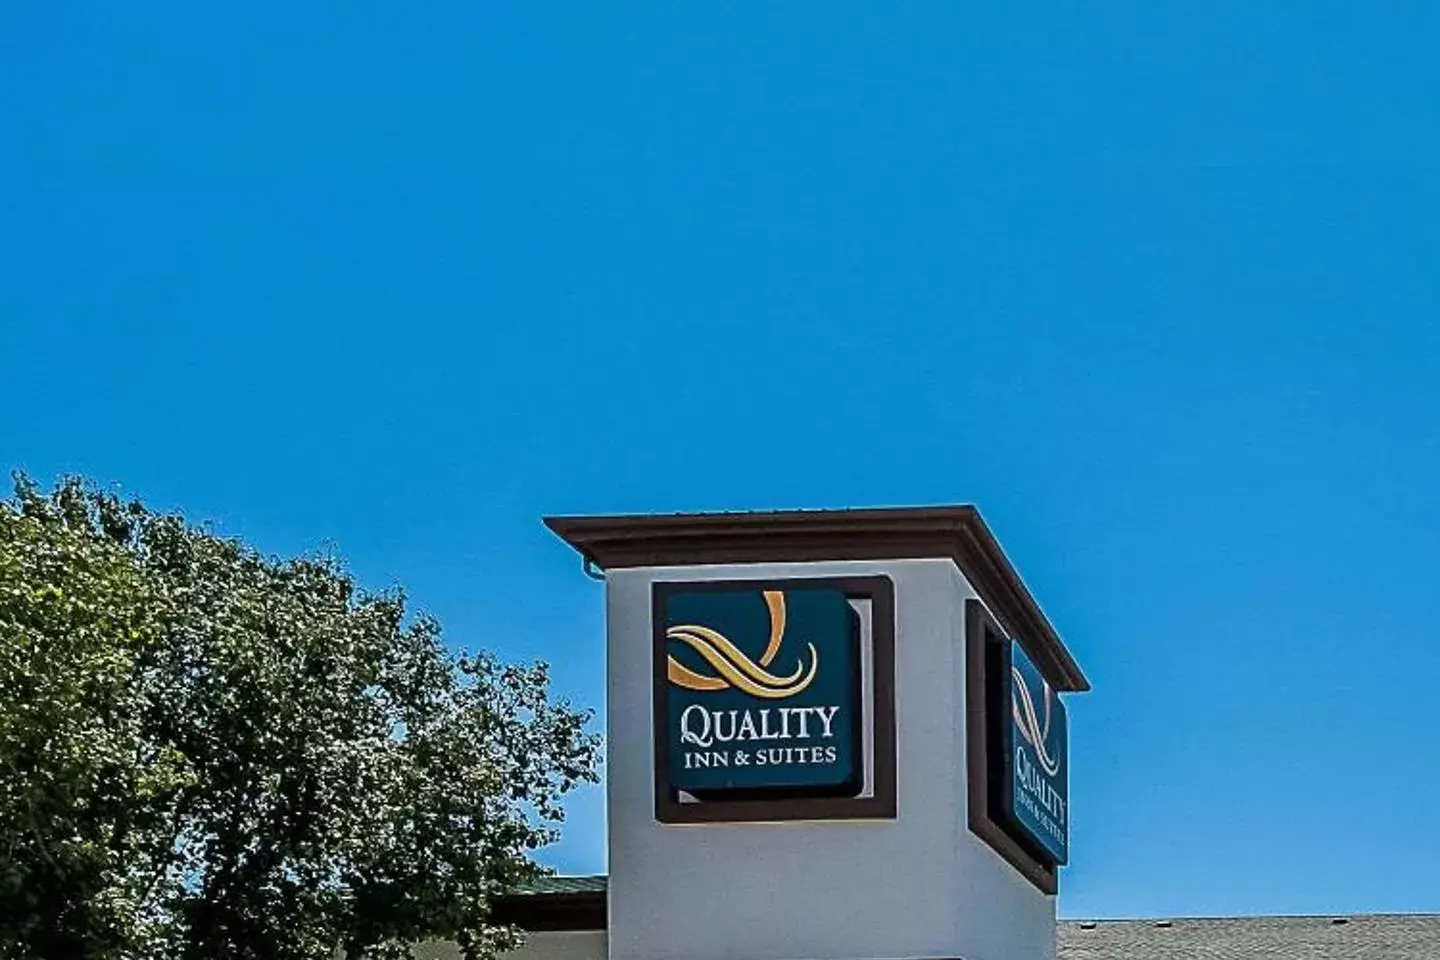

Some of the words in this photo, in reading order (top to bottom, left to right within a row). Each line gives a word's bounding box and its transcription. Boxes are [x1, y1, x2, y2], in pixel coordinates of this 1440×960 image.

[680, 704, 840, 748] QUALITY
[684, 752, 729, 769] INN
[734, 750, 750, 765] &
[755, 746, 837, 766] SUITES
[1016, 746, 1066, 827] QUALITY
